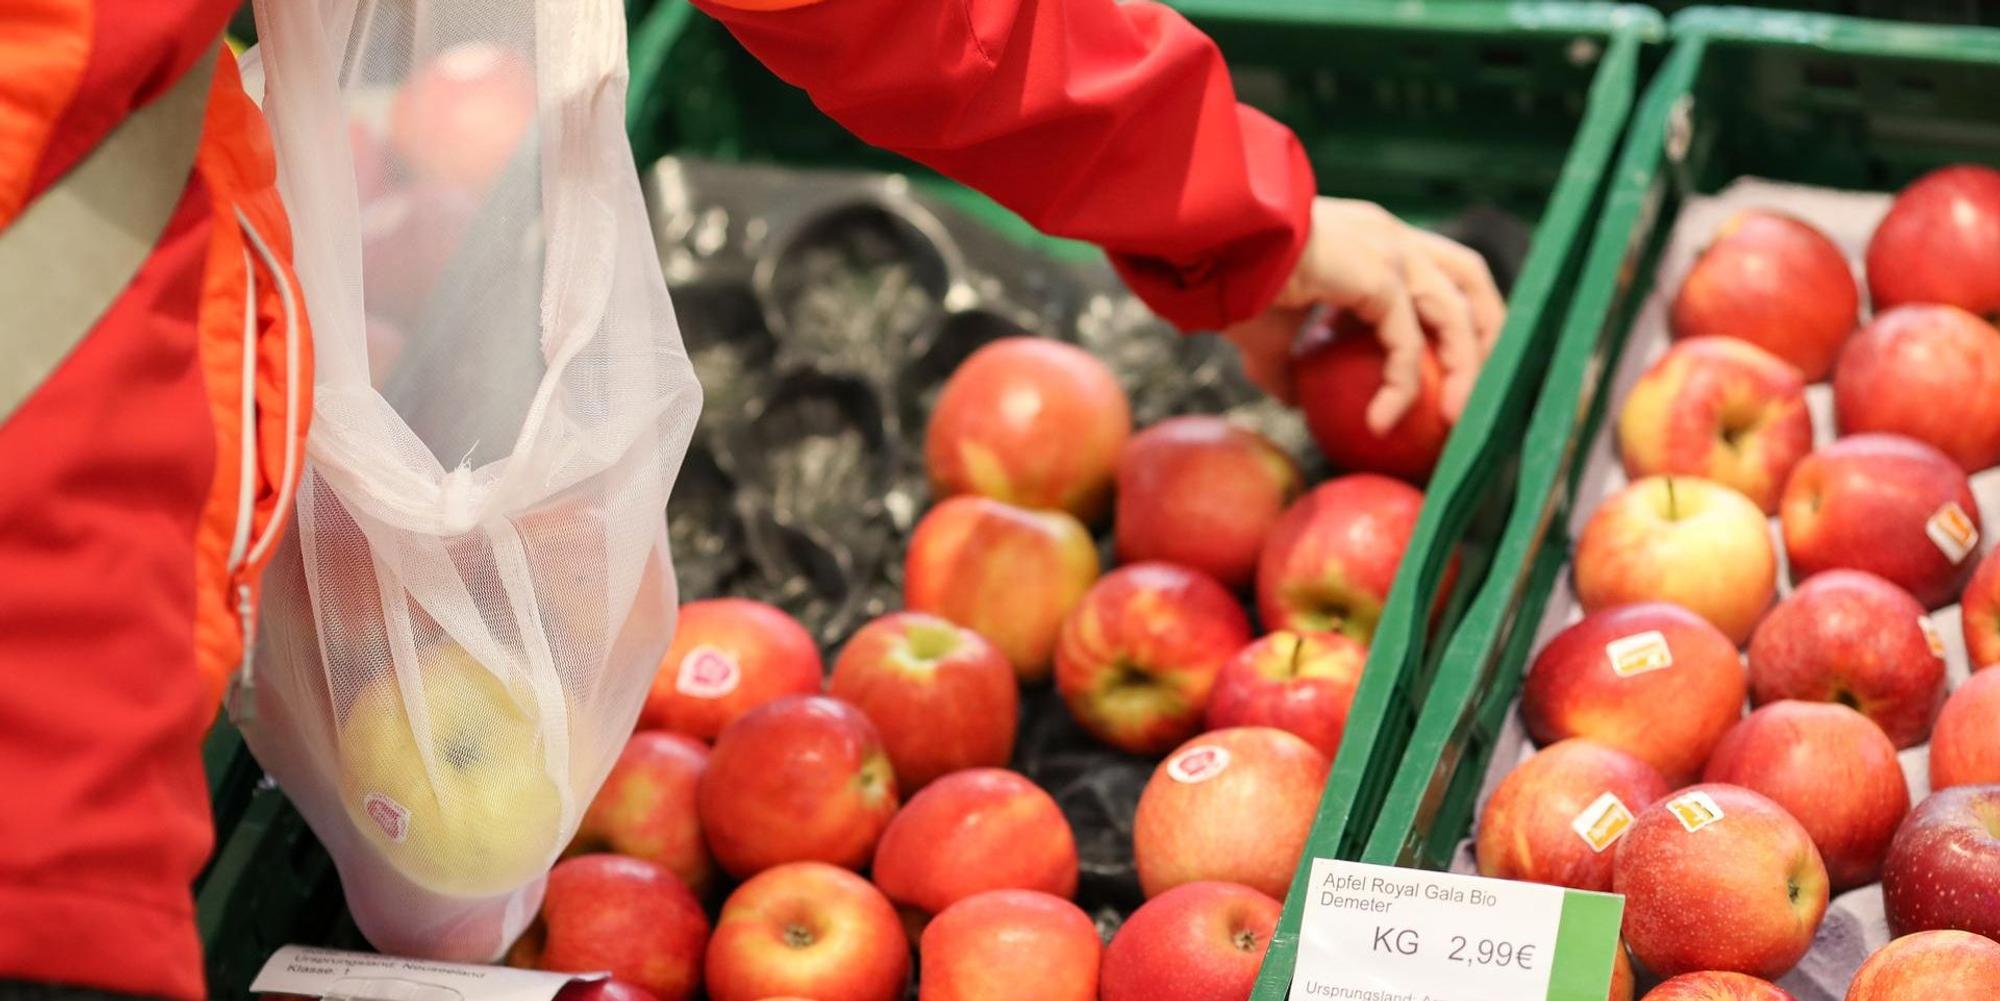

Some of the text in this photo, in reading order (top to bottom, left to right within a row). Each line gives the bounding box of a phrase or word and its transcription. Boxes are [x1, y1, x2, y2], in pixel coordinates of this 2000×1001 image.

[1320, 891, 1393, 913] Demeter
[1322, 873, 1497, 907] Apfel Royal Gala Bio
[1372, 926, 1537, 970] KG 2,99€
